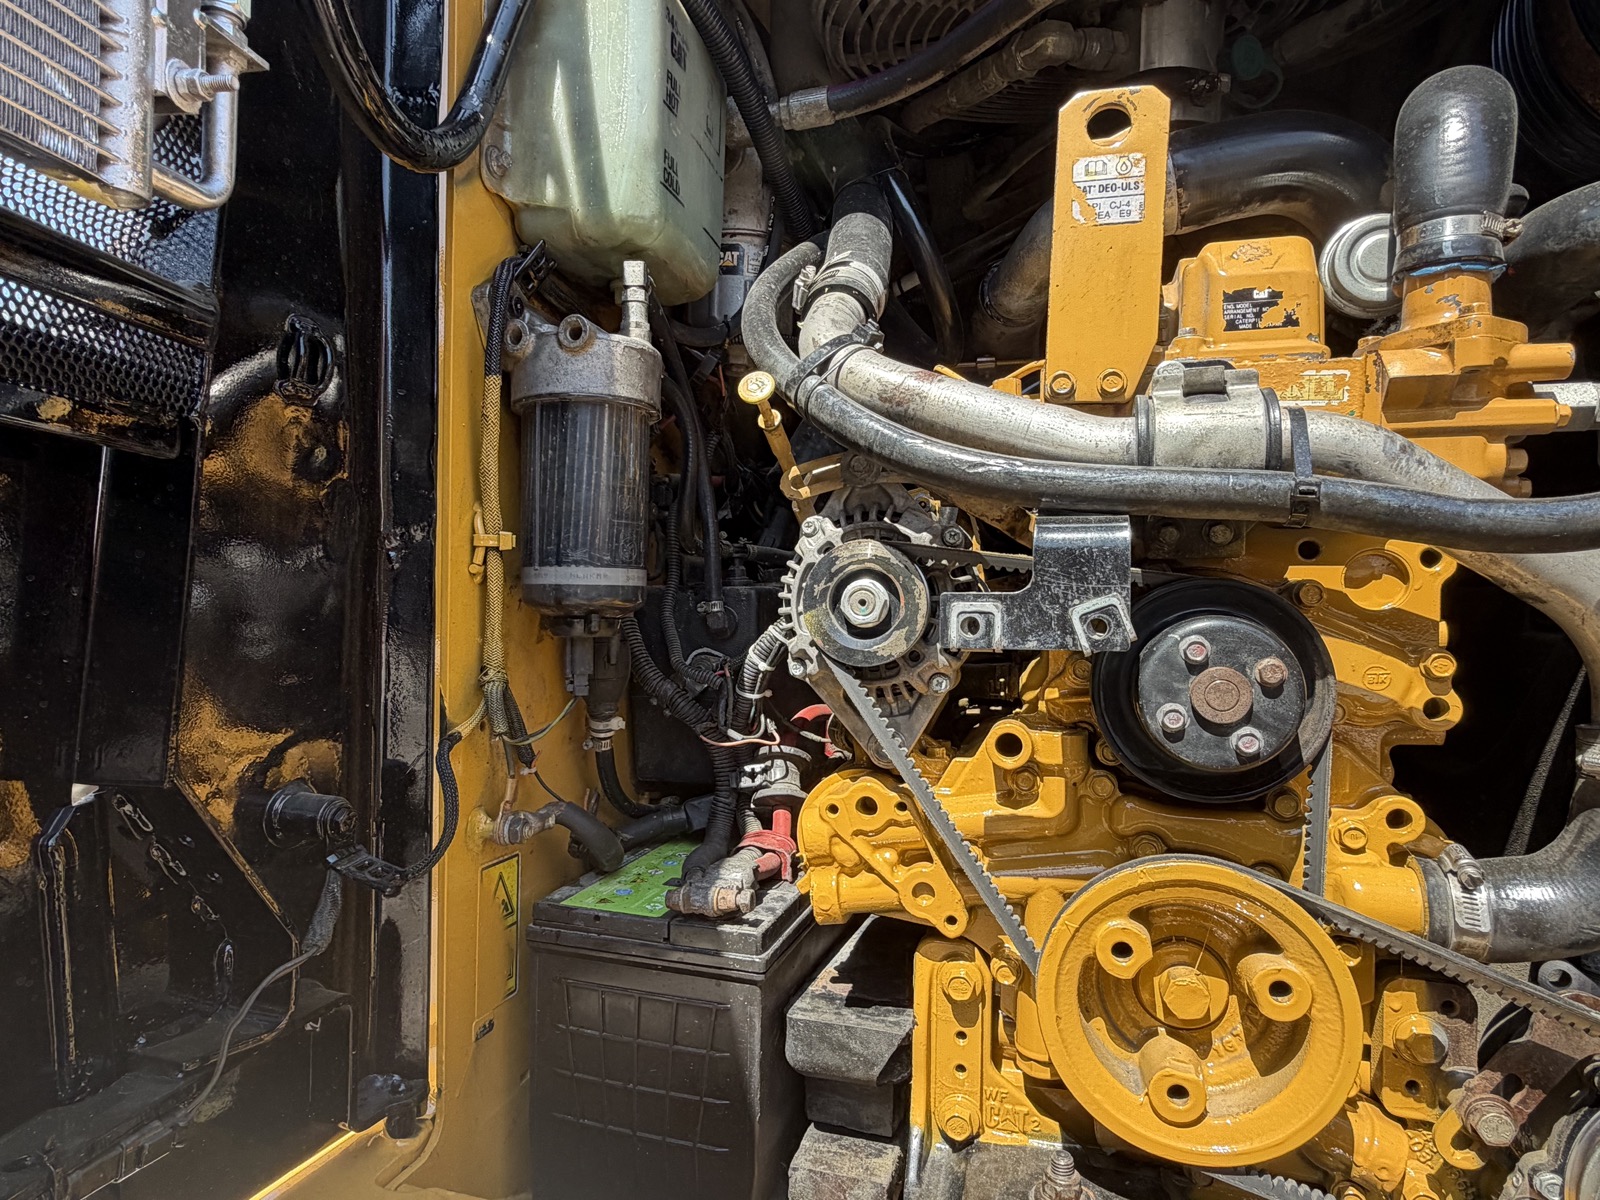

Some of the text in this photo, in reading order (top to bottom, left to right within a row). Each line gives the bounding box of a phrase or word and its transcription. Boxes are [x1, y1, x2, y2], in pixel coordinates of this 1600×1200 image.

[671, 31, 687, 72] CAT
[666, 69, 681, 100] FULL
[666, 86, 679, 114] HOT
[663, 148, 678, 178] FULL
[663, 167, 680, 196] COLD
[1098, 181, 1140, 193] DEO-ULS
[1109, 201, 1131, 209] CJ-4
